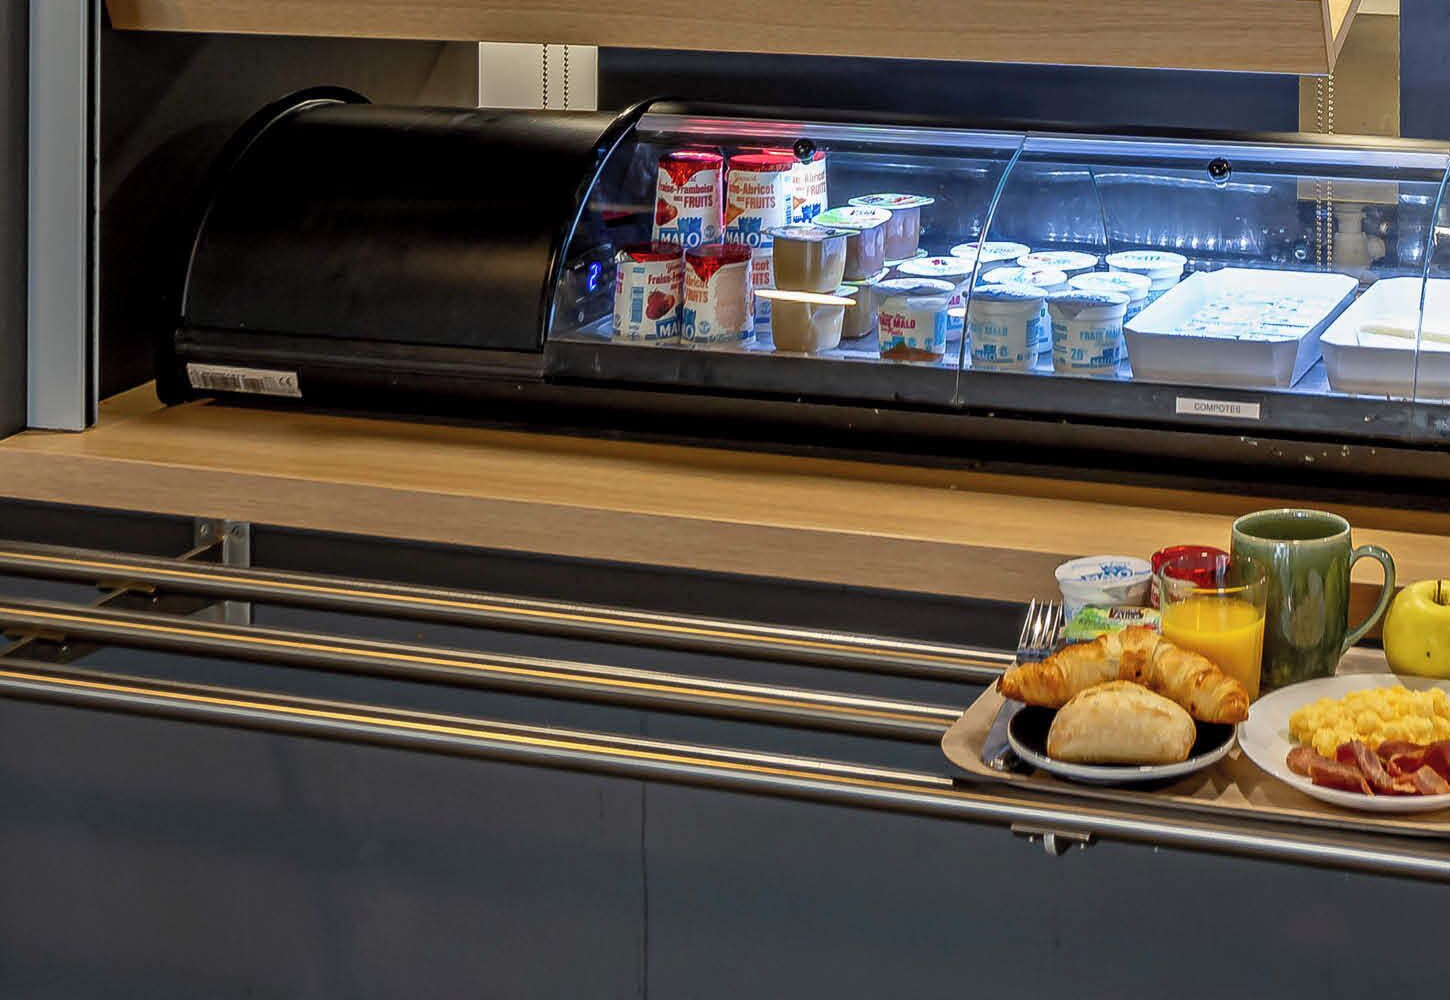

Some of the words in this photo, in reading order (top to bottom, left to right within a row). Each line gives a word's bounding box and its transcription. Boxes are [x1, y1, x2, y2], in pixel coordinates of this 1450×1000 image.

[683, 195, 713, 209] FRUITS
[745, 196, 776, 209] FRUITS
[893, 319, 916, 329] MALO
